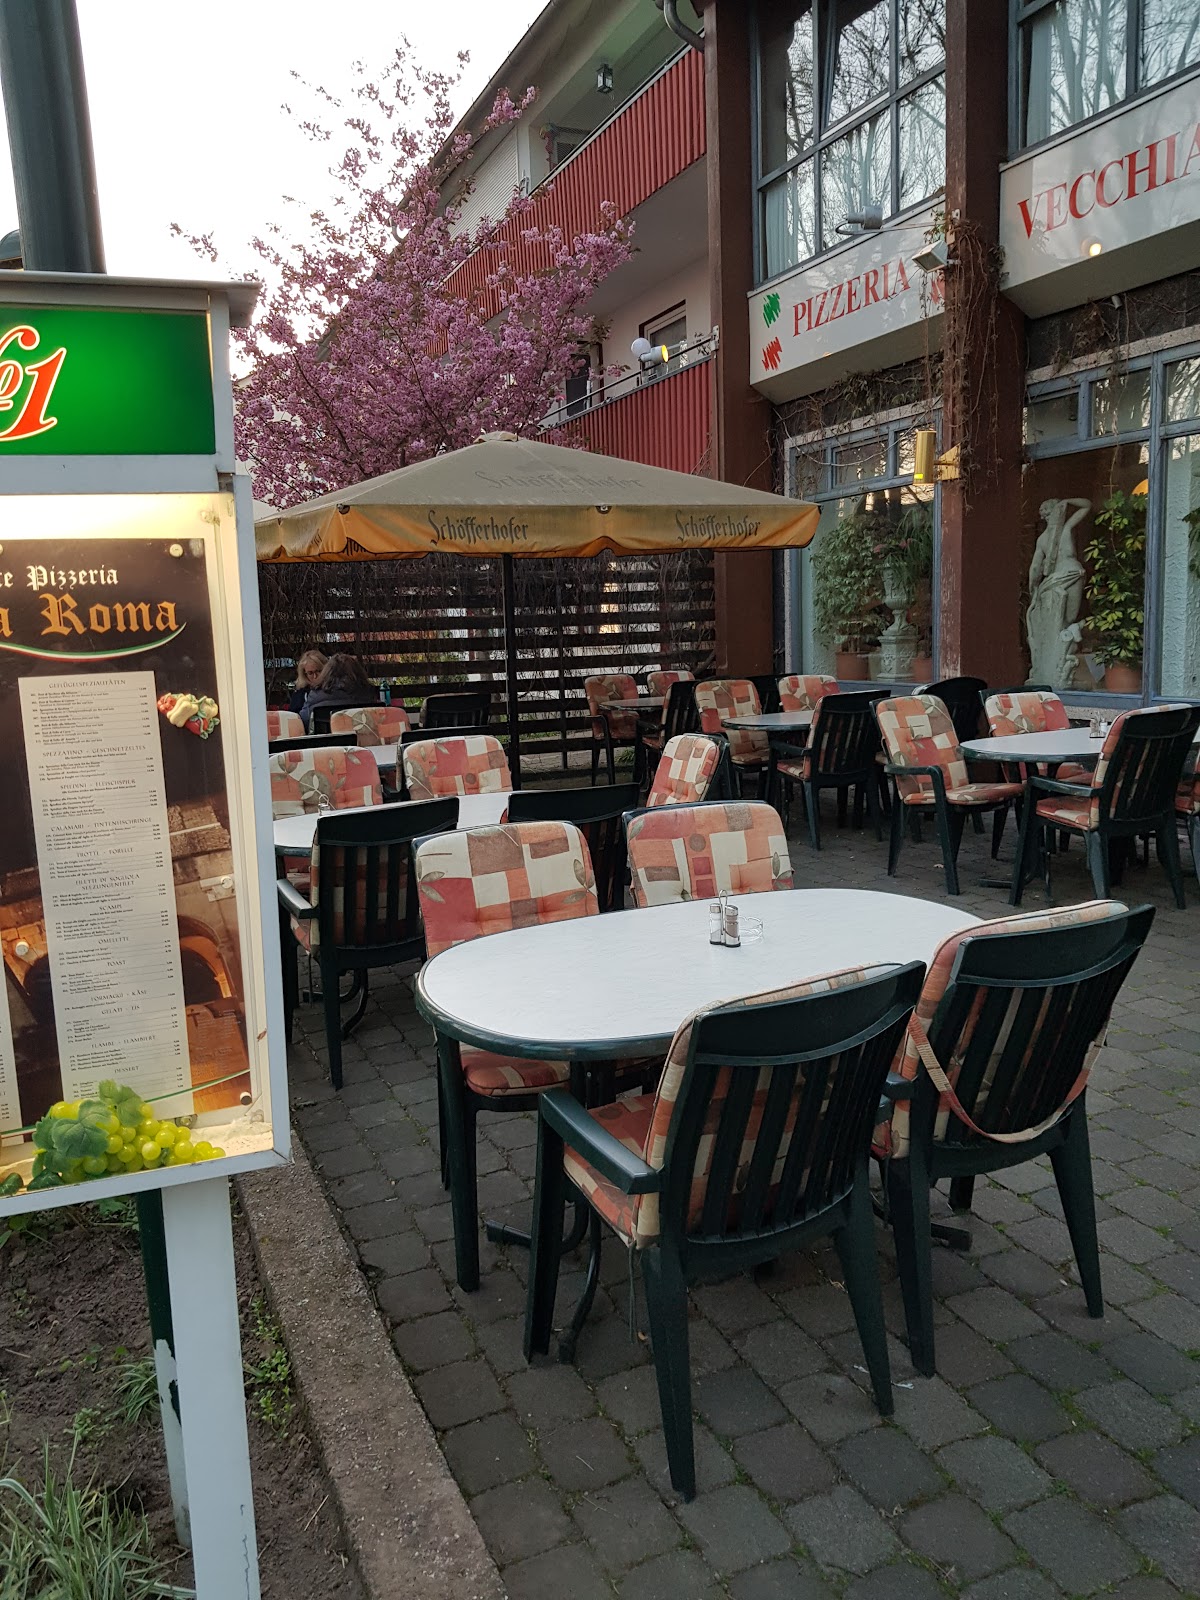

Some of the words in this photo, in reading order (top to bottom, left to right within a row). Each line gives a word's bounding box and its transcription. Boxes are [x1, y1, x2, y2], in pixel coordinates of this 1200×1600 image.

[792, 257, 911, 337] PIZZERIA
[428, 510, 529, 545] Schöfferhofer
[675, 509, 761, 543] Schöfferhofer
[26, 565, 119, 591] Pizzeria
[38, 593, 180, 636] Roma
